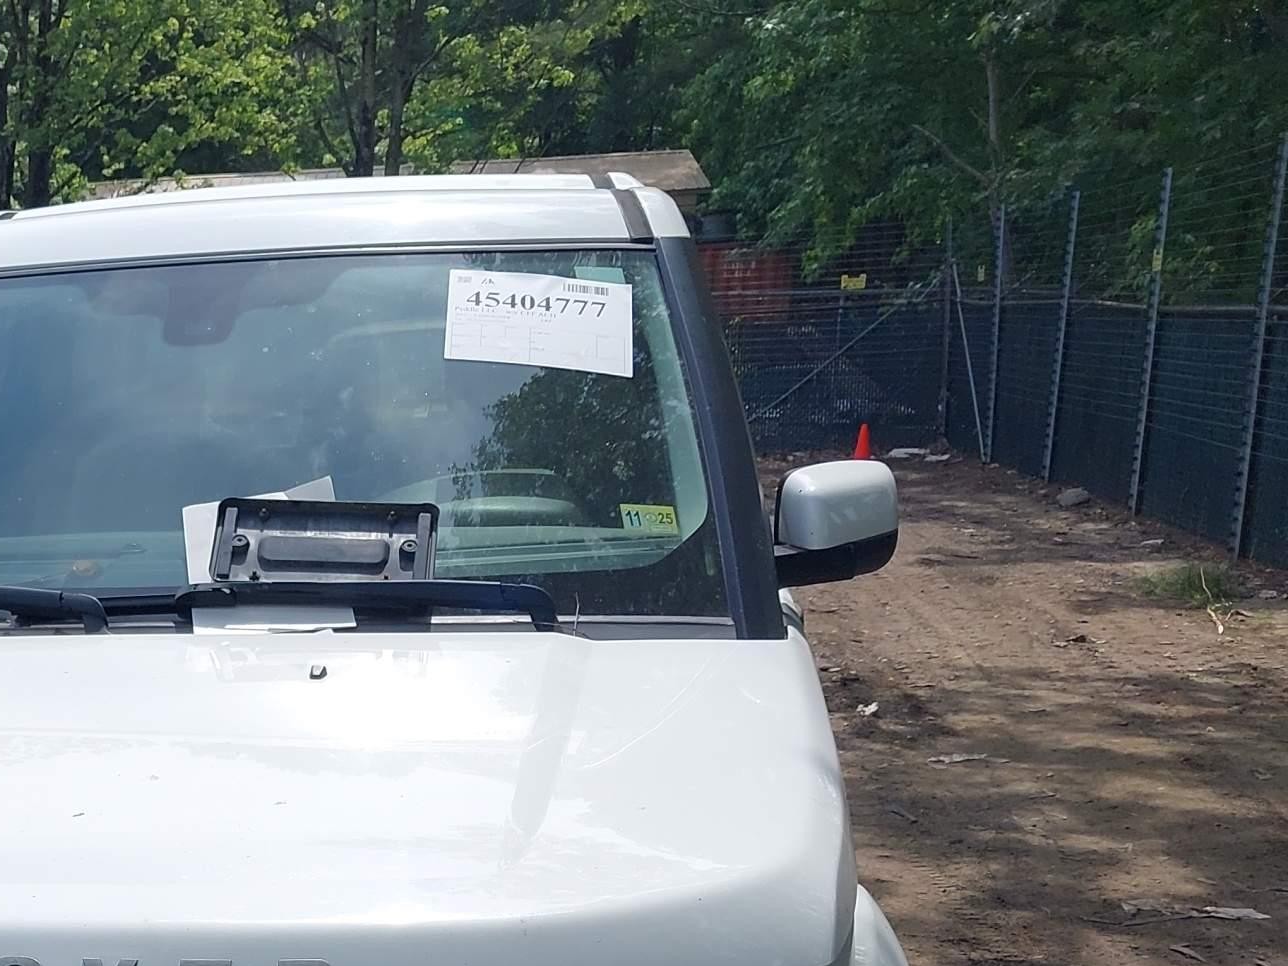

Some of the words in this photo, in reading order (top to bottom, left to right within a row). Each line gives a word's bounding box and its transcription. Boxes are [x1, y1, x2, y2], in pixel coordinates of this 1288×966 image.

[466, 291, 607, 318] 45404777
[625, 510, 642, 527] 11
[657, 512, 674, 525] 25
